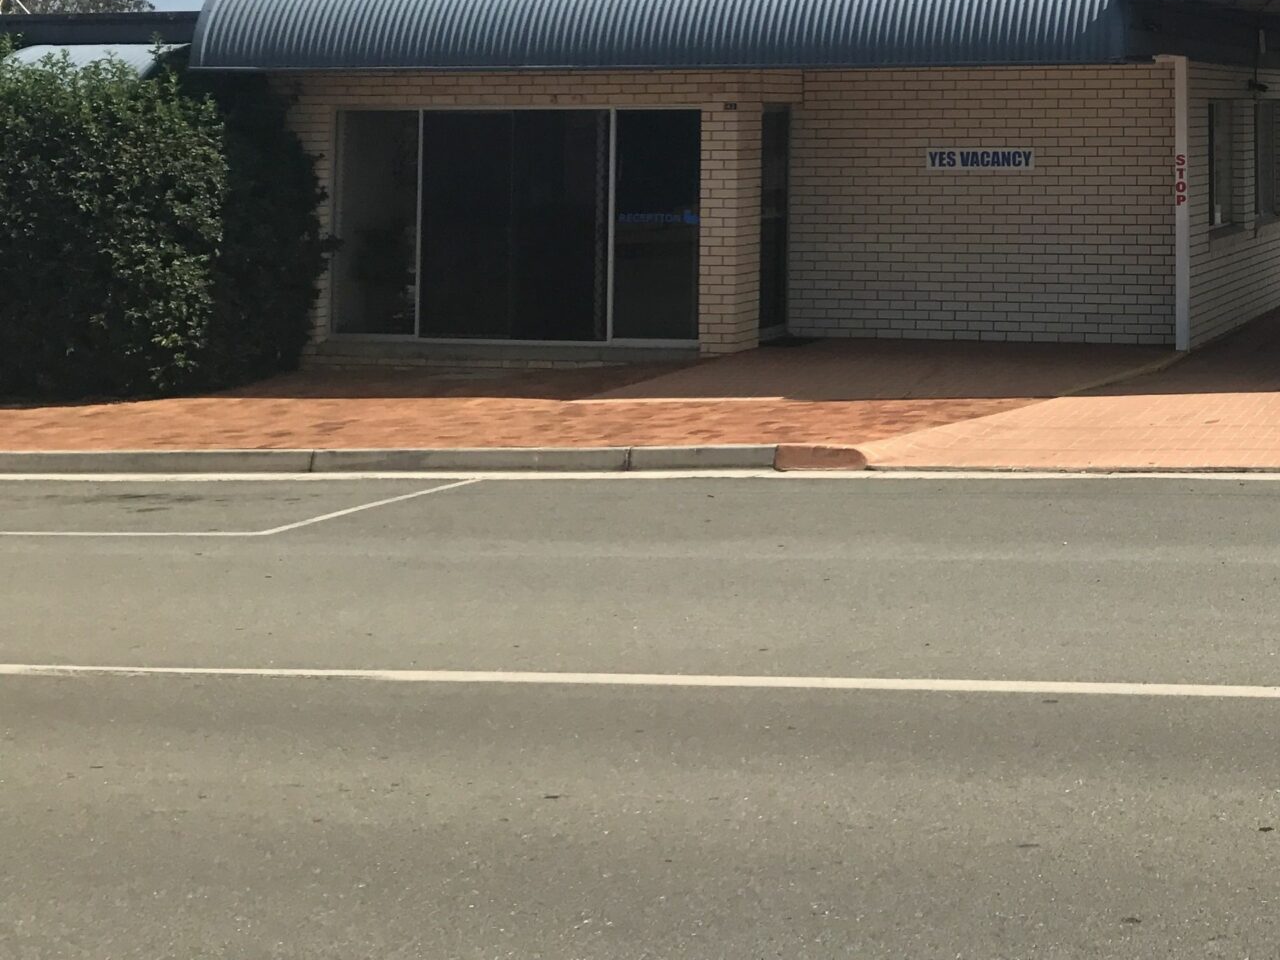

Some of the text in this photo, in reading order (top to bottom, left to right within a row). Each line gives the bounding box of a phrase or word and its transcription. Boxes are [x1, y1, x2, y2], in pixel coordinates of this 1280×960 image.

[929, 151, 1032, 167] YES VACANCY
[1175, 154, 1187, 206] STOP
